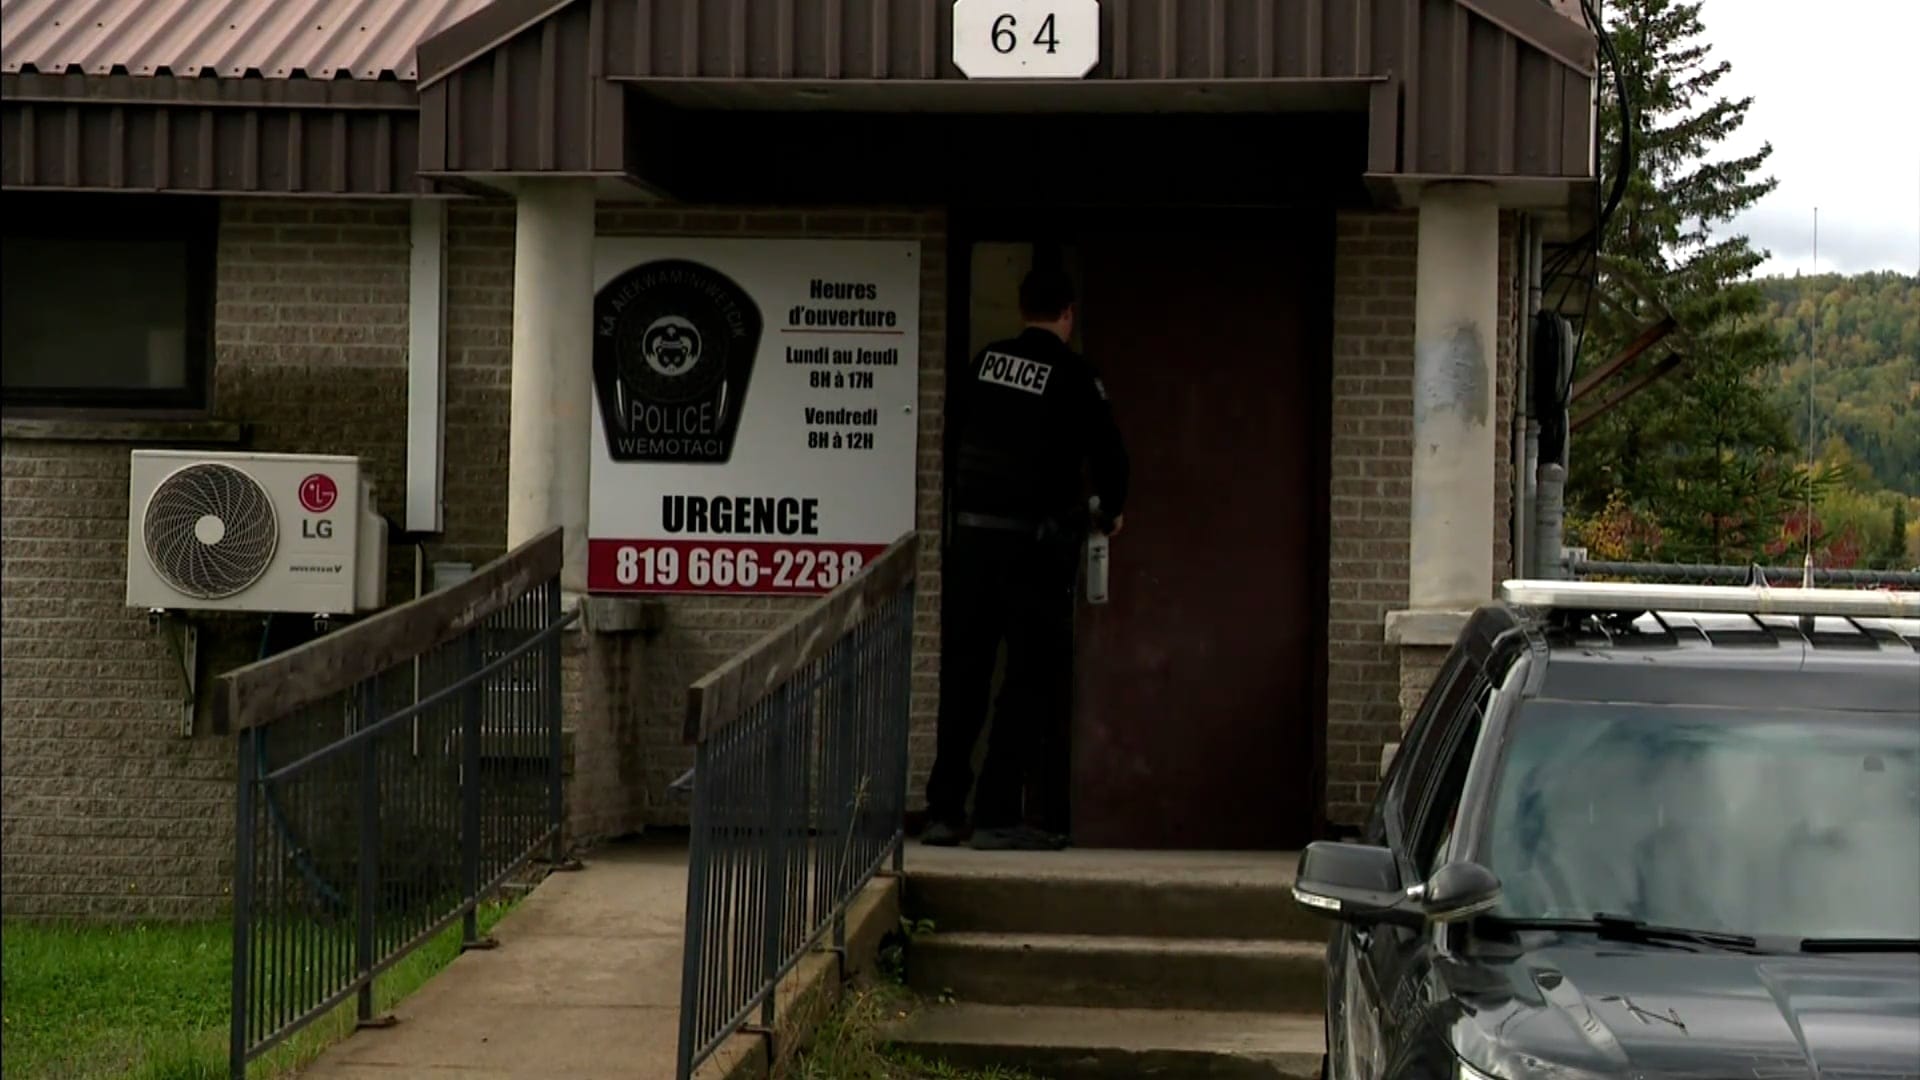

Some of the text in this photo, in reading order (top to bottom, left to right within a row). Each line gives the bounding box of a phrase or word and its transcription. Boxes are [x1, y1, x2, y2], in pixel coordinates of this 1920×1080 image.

[991, 13, 1060, 54] 64
[810, 280, 877, 300] Heures
[600, 315, 617, 337] KA
[786, 347, 898, 366] Lundi au Jeudi
[810, 371, 873, 389] 8H à 17H
[982, 355, 1048, 389] POLICE
[631, 401, 712, 434] POLICE
[805, 407, 878, 426] Vendredi
[618, 438, 724, 455] WEMOTACI
[808, 431, 873, 449] 8H à 12H
[662, 496, 819, 535] URGENCE
[303, 519, 332, 538] LG
[617, 547, 863, 588] 819 666-2238
